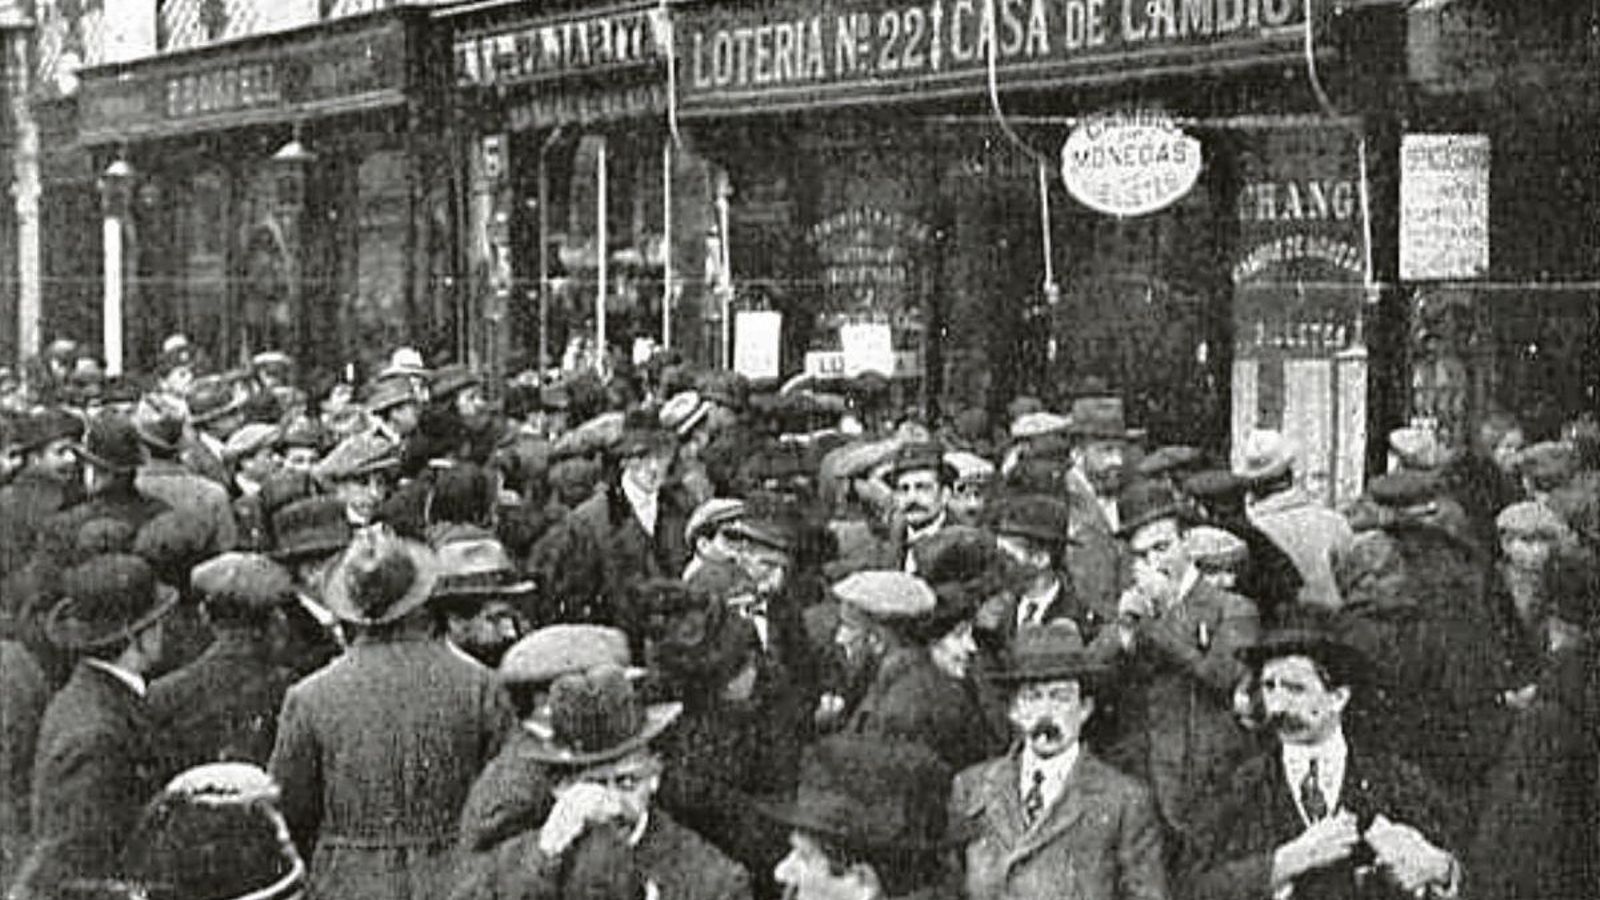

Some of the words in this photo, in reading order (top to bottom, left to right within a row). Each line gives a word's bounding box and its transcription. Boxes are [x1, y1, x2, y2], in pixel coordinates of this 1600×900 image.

[693, 16, 825, 88] LOTERIA
[950, 0, 1049, 61] CASA
[1065, 1, 1106, 50] DE
[1238, 181, 1366, 220] CHANG
